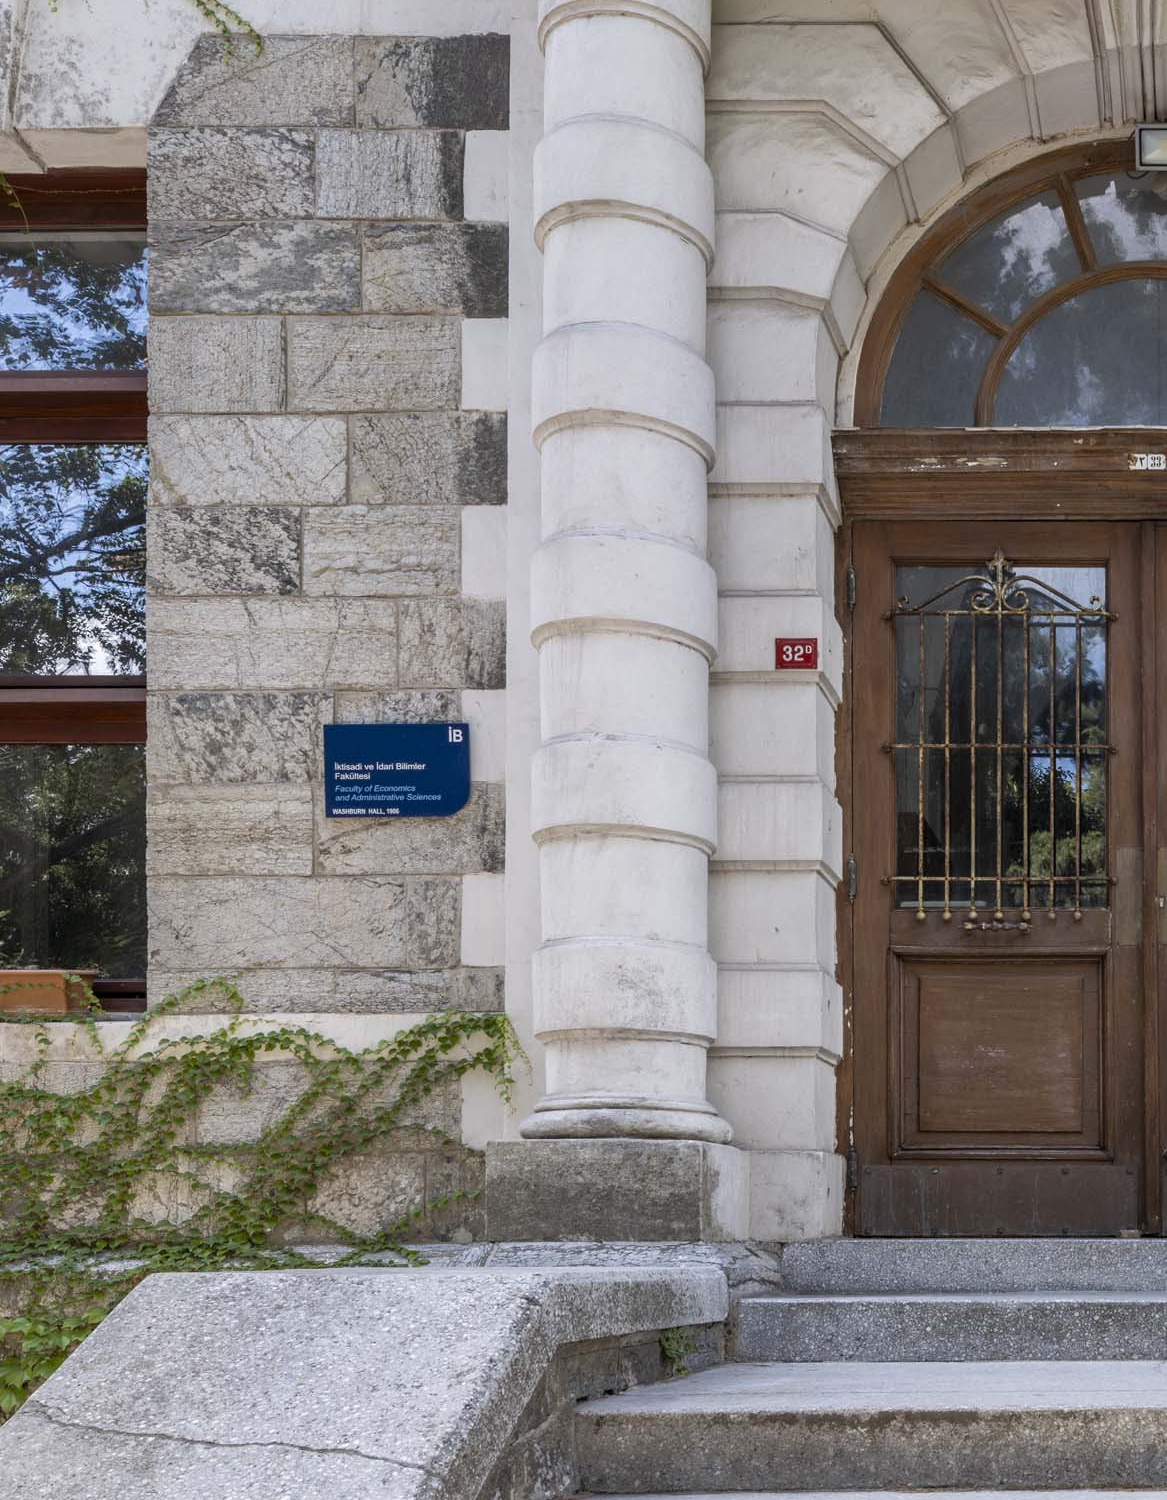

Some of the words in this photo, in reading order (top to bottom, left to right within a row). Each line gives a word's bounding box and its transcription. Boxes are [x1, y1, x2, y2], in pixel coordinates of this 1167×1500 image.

[448, 726, 463, 743] İB
[334, 762, 362, 771] İktisadi
[376, 761, 394, 771] İdari
[395, 762, 426, 771] Bilimler
[334, 771, 371, 780] Fakültesi
[335, 785, 363, 794] Faculty
[373, 785, 416, 793] Economics
[351, 793, 405, 802] Administrative
[406, 793, 442, 801] Sciences
[368, 808, 386, 816] HALL,
